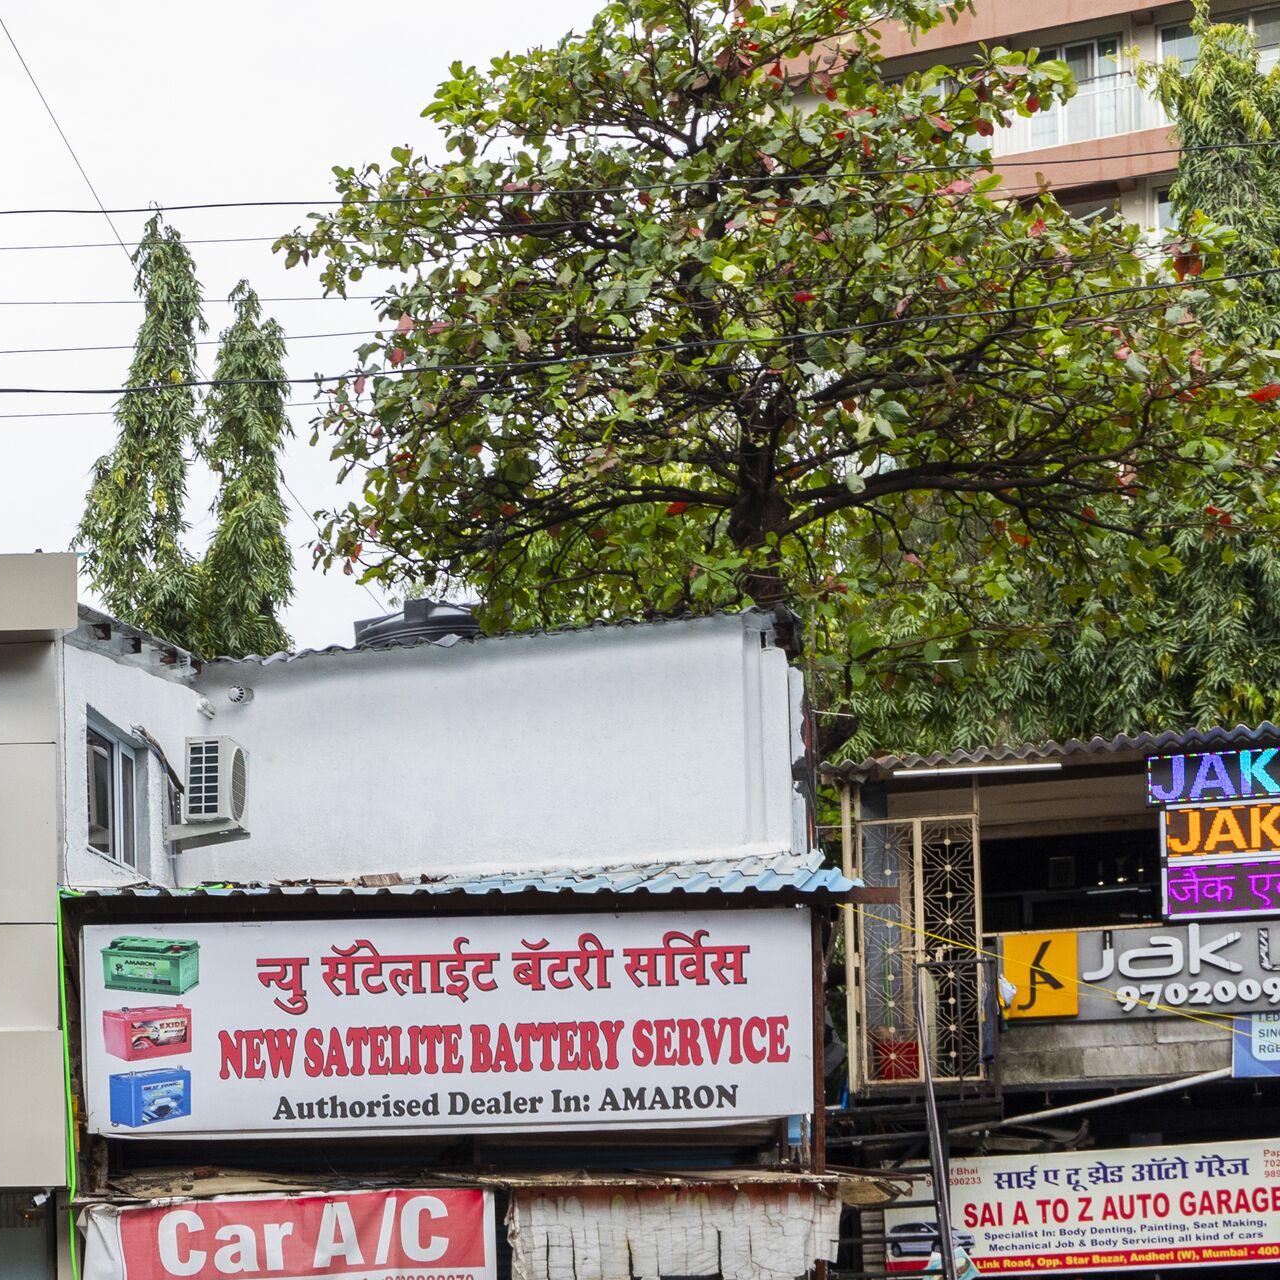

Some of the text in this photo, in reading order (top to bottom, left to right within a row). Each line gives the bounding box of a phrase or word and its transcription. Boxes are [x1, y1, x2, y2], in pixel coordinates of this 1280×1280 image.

[512, 933, 614, 991] बॅटरी
[623, 930, 750, 987] सर्विस
[218, 1015, 790, 1080] NEW SATELITE BATTERY SERVICE
[273, 1084, 738, 1120] Authorised Dealer In: AMARON
[994, 1165, 1038, 1190] साई
[1043, 1169, 1060, 1186] ए
[964, 1186, 1280, 1228] SAI A TO Z AUTO GARAGE
[158, 1209, 294, 1277] Car
